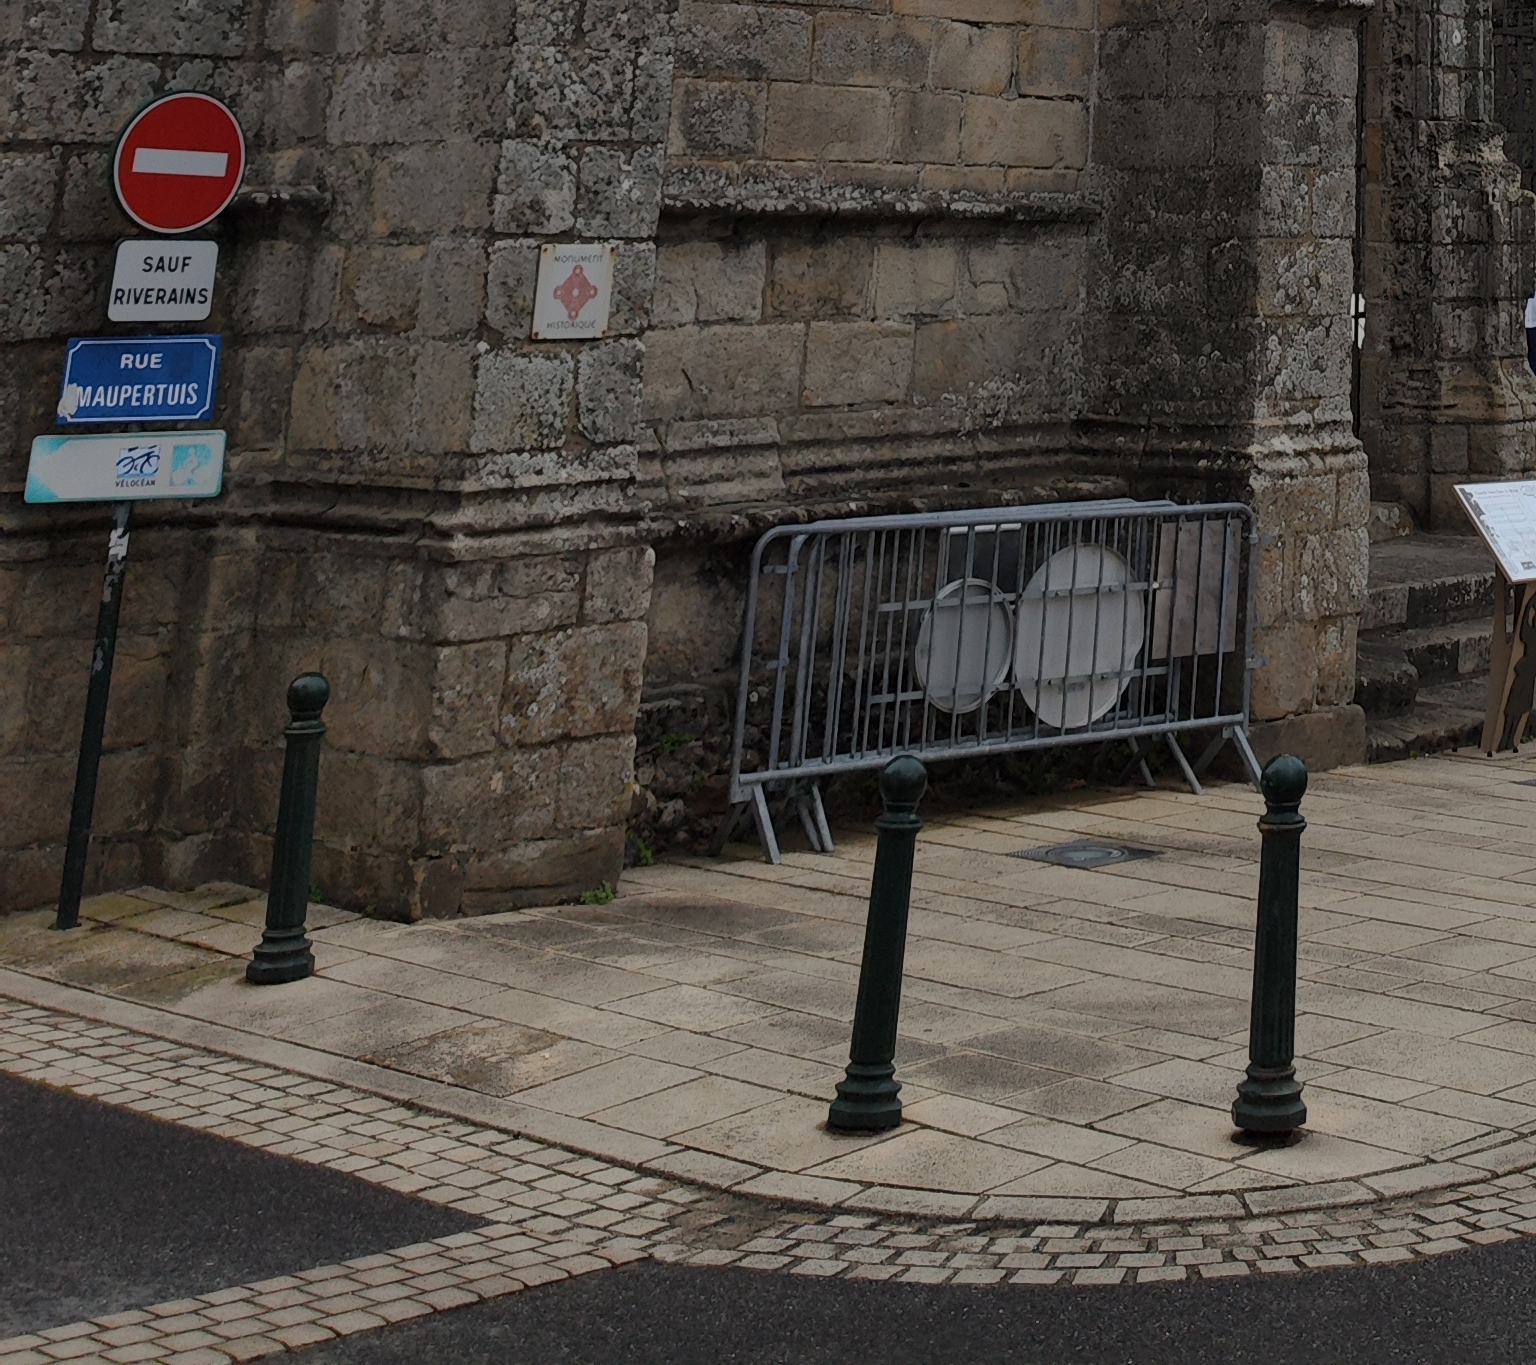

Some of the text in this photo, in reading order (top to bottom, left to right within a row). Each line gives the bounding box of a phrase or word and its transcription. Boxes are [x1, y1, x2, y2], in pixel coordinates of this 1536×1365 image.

[142, 256, 193, 273] SAUF
[554, 254, 603, 264] MONUMENT
[113, 288, 209, 305] RIVERAINS
[547, 320, 597, 329] HISTORIQUE
[120, 353, 163, 369] RUE
[77, 383, 199, 408] MAUPERTUIS
[115, 478, 156, 488] VÉLOCÉAN
